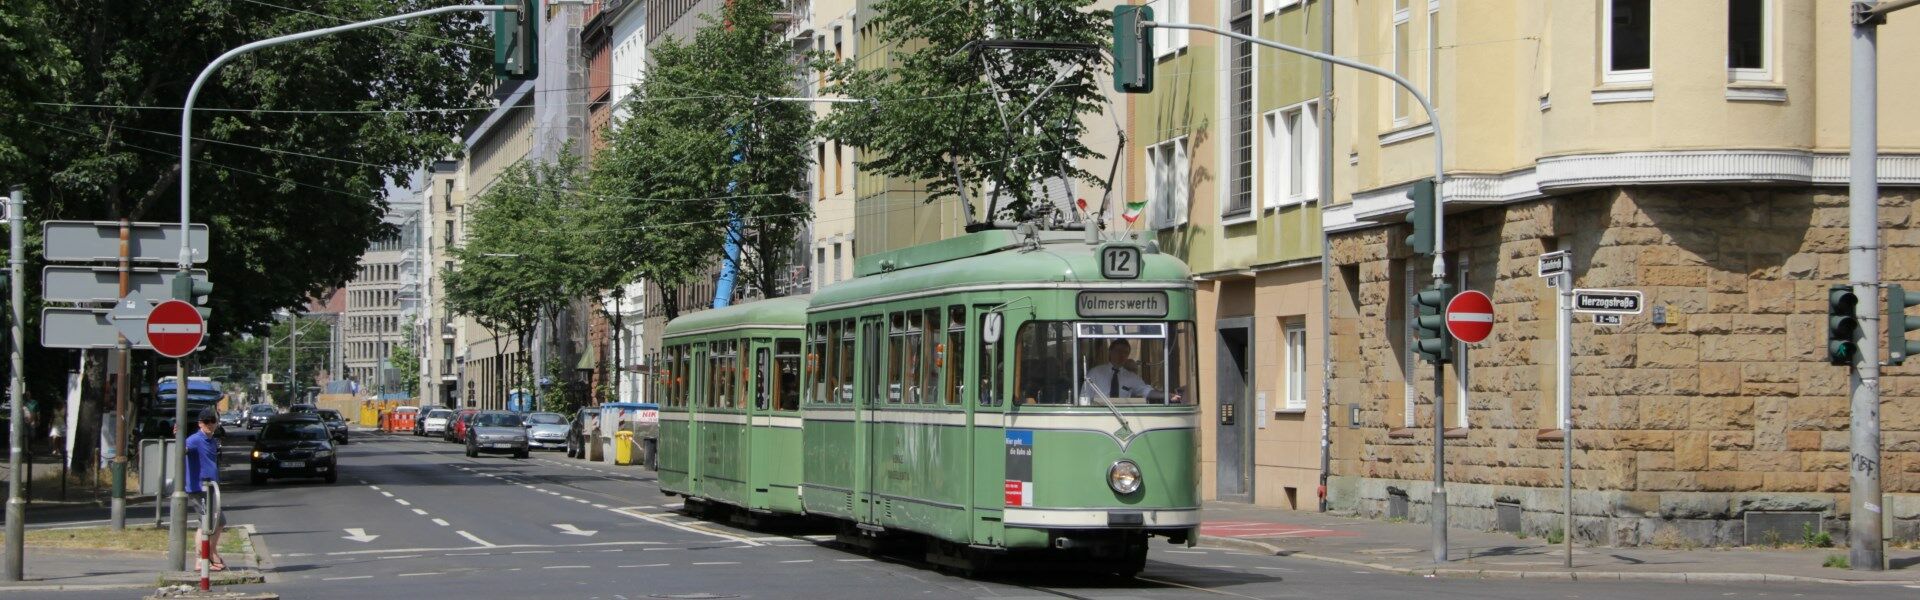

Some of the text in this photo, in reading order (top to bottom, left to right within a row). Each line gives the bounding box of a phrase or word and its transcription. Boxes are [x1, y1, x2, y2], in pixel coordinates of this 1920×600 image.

[1108, 250, 1131, 272] 12
[1080, 295, 1158, 310] Volmerswerth
[1581, 295, 1635, 309] Herzogstraße
